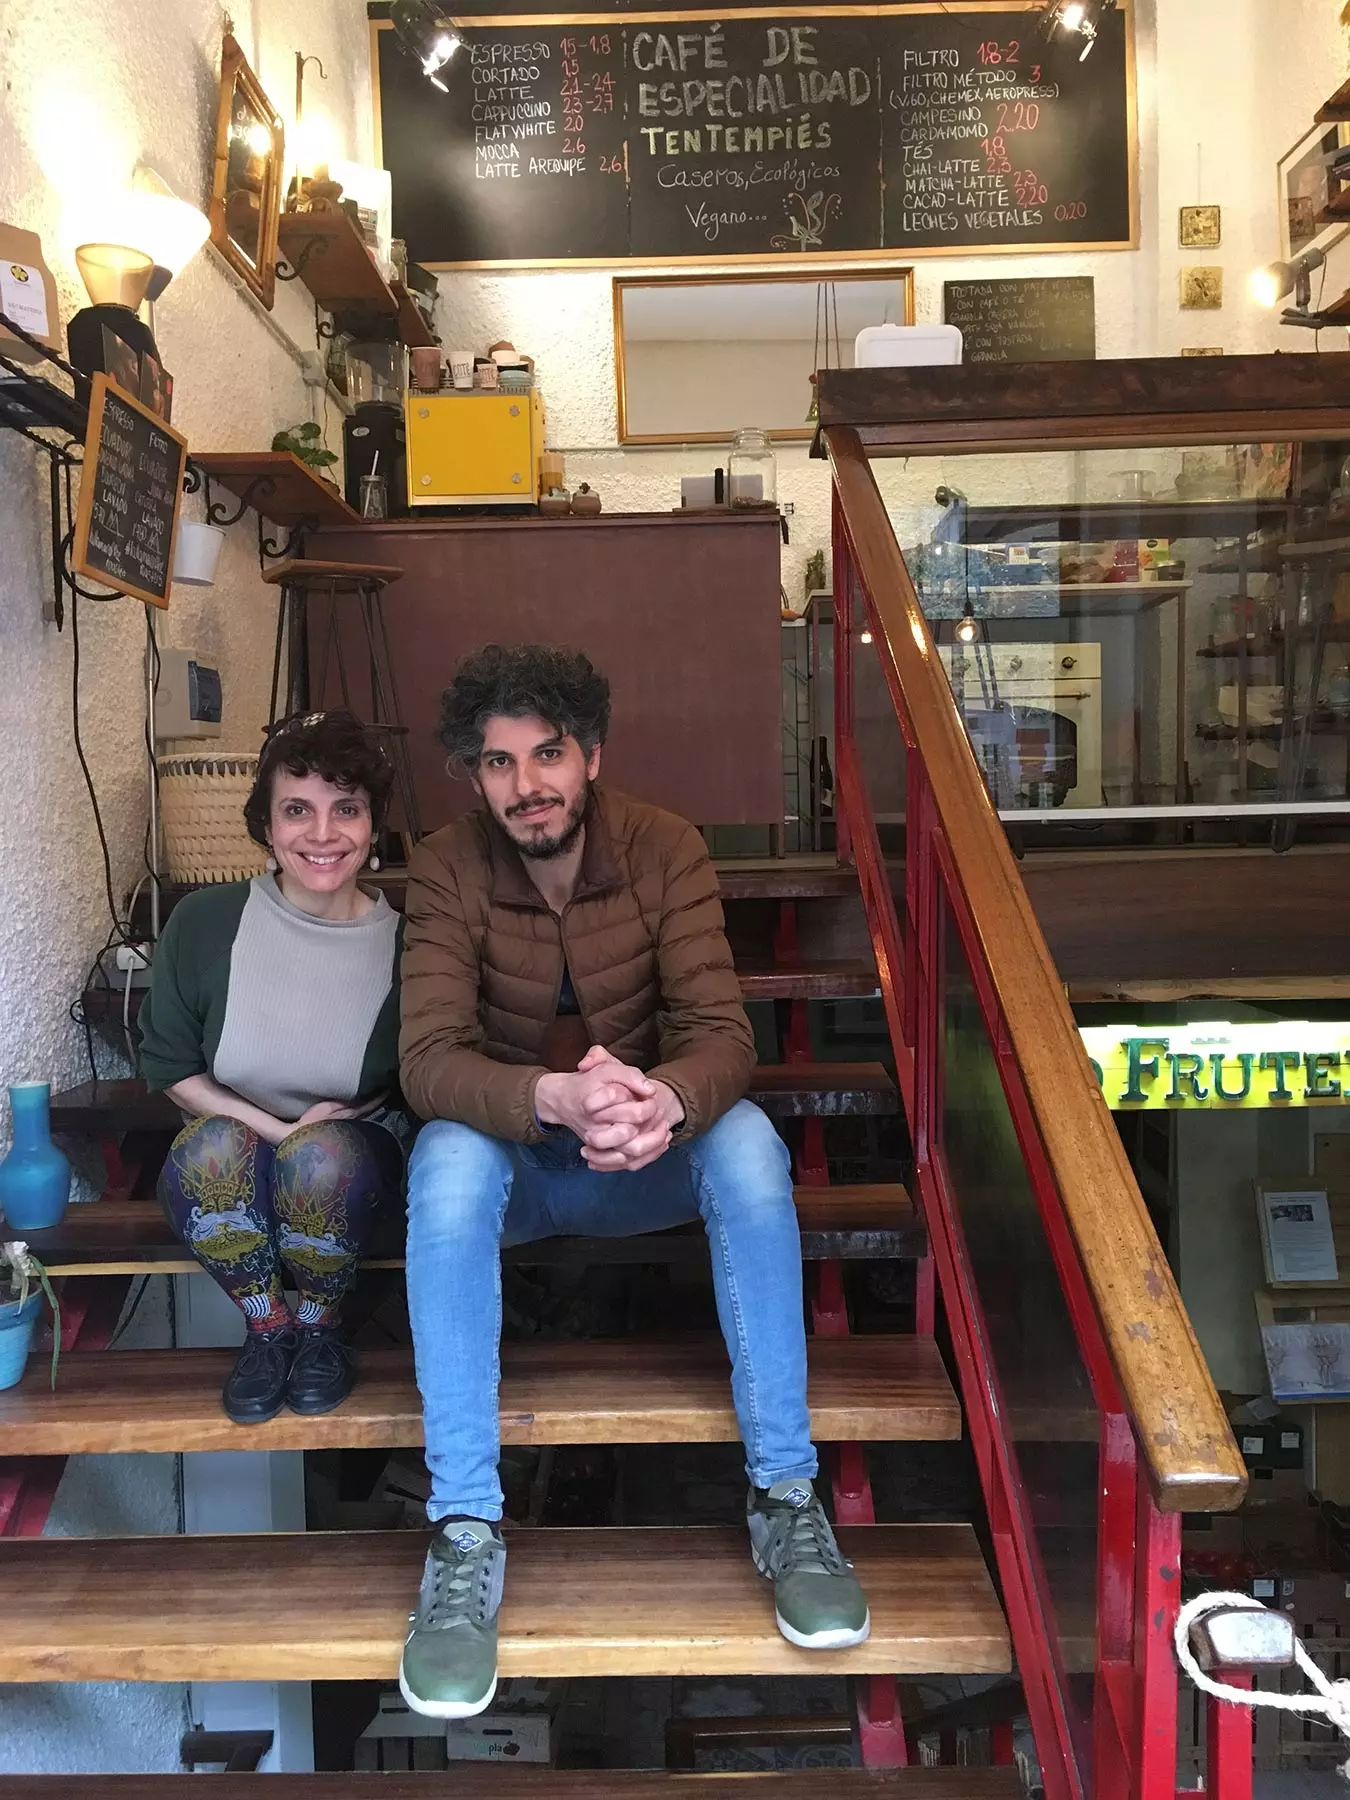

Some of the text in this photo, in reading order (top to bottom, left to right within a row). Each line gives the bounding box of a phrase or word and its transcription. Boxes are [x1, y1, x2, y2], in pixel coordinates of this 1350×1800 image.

[471, 41, 550, 64] ESPRESSO
[633, 22, 819, 72] CAFÉ DE
[903, 49, 959, 70] FILTRO
[472, 66, 540, 85] CORTADO
[903, 64, 1041, 92] FILTRO MÉTODO 3
[474, 85, 534, 102] LATTE
[639, 67, 871, 118] ESPECIALIDAD
[985, 82, 1060, 101] AEROPRESS)
[472, 101, 550, 122] CAPPUCCINO
[900, 105, 981, 127] CAMPESINO
[475, 120, 556, 143] FLAT WHITE
[564, 115, 584, 132] 2,0
[900, 122, 989, 143] CARDAMOMO
[475, 137, 586, 162] MOCCA 2,6
[903, 136, 1005, 161] TÉS 1,8
[475, 155, 622, 179] LATTE AREQUIPE 2,6
[657, 158, 840, 191] Caseros, Ecológicos
[903, 158, 980, 178] CHAI-LATTE
[905, 174, 1004, 194] MATCHA-LATTE
[903, 184, 1048, 209] CACAO-LATTE 2,20
[903, 201, 1087, 231] LECHES VEGETALES 0,20
[999, 284, 1017, 293] CON
[957, 300, 974, 311] CON
[1119, 1037, 1350, 1101] FRUTE
